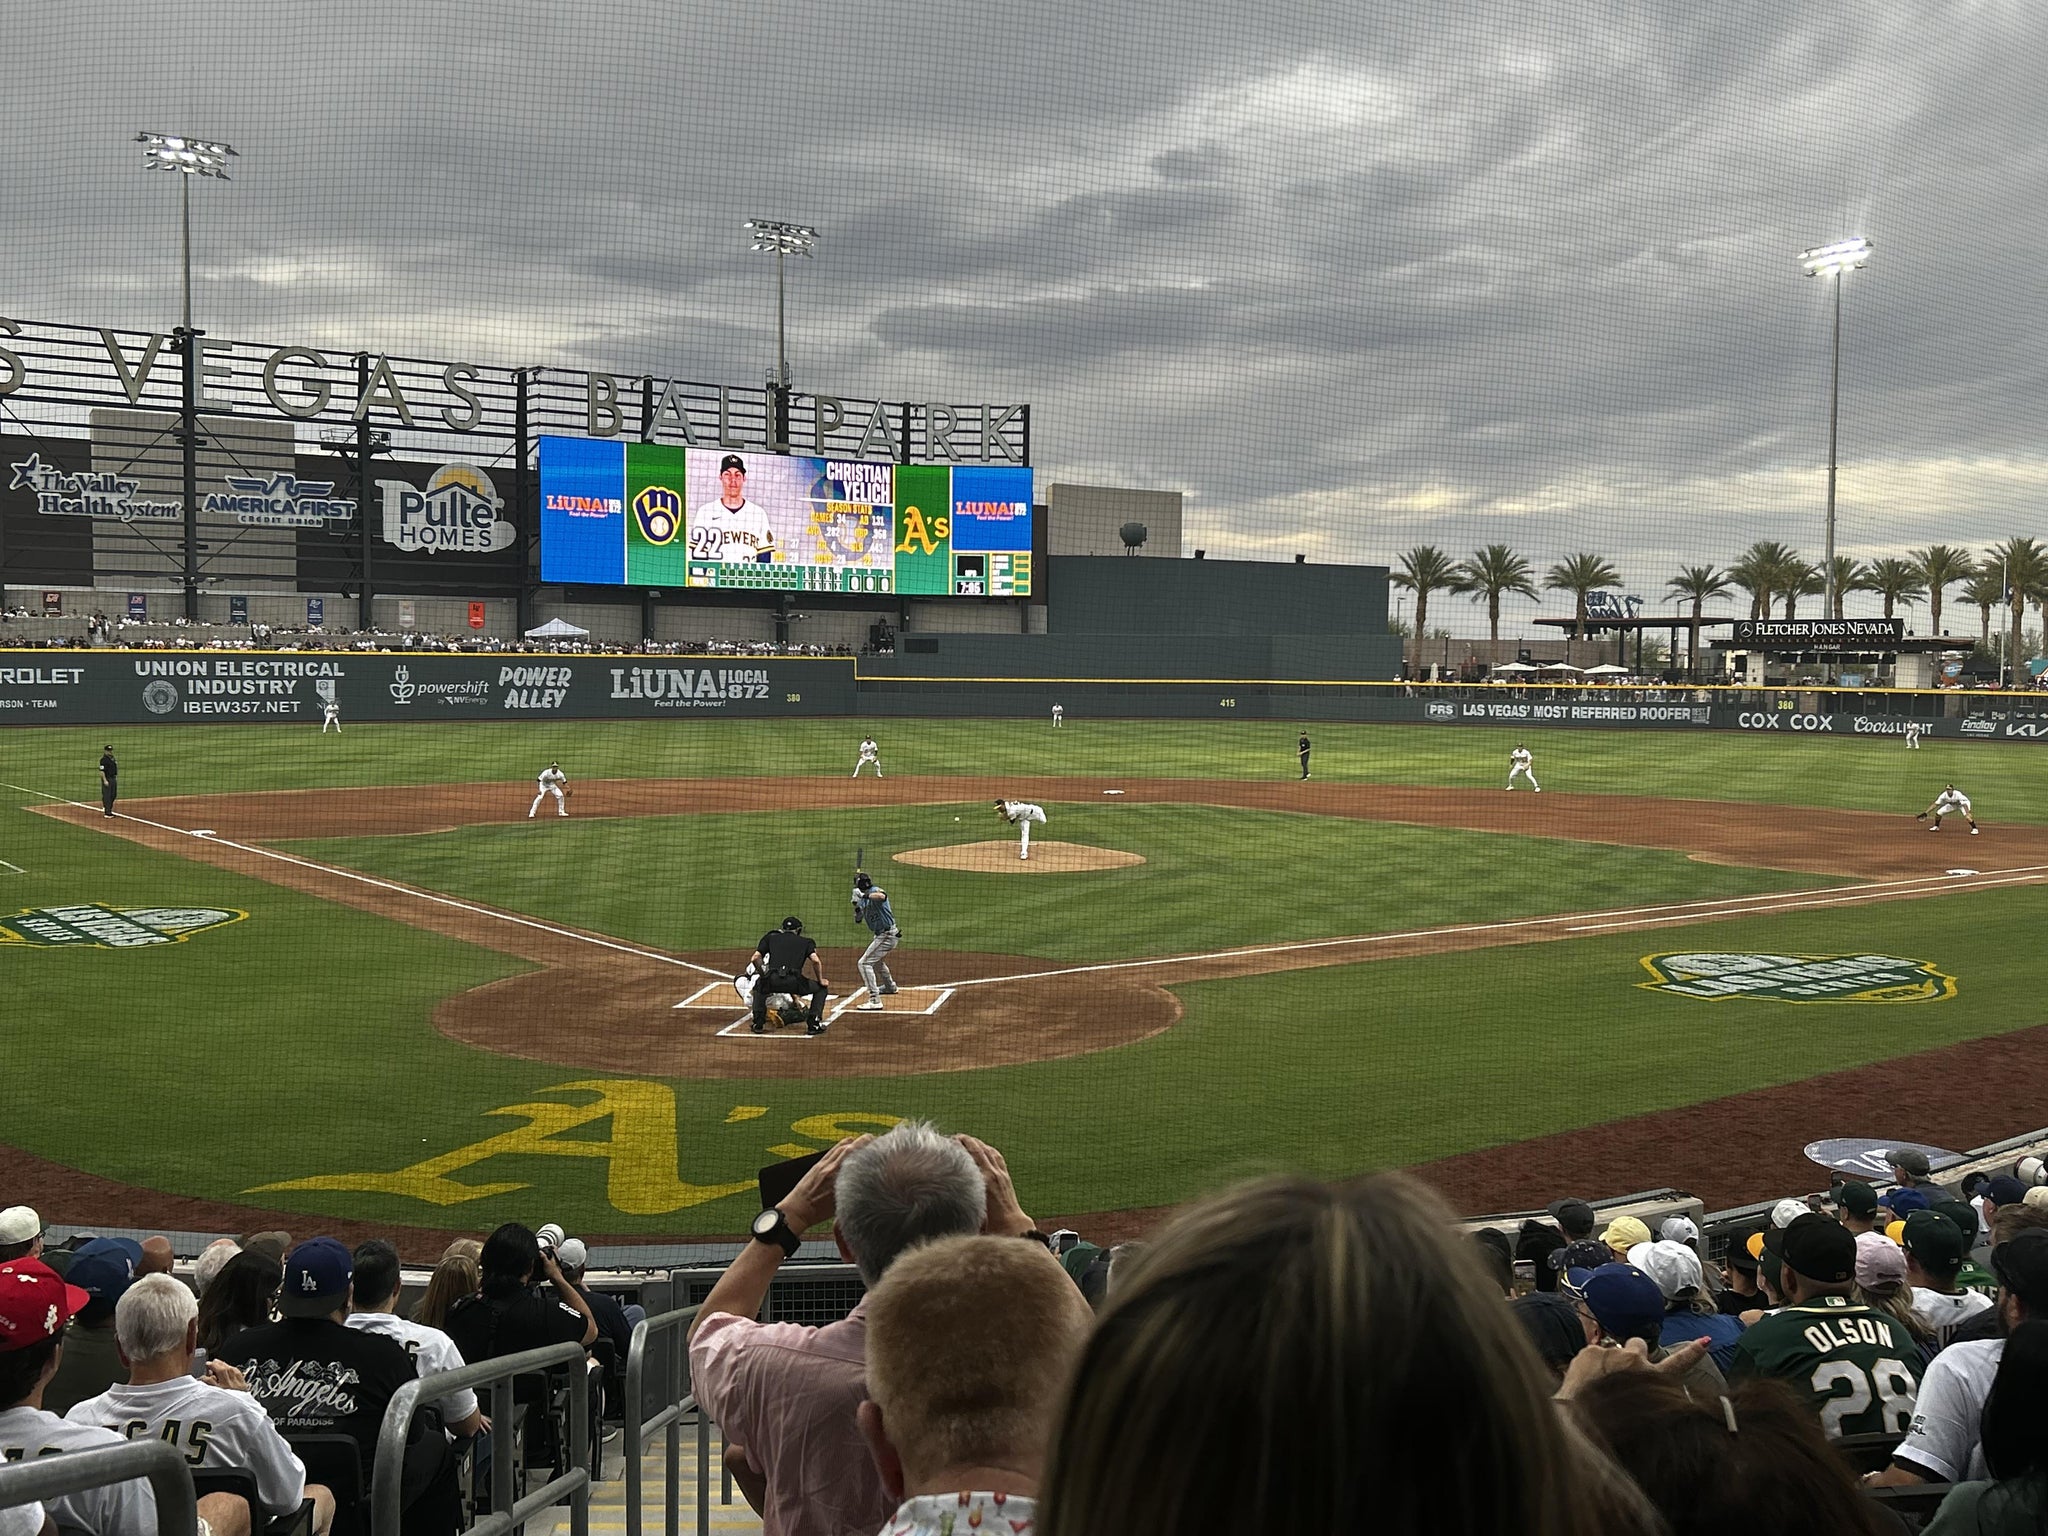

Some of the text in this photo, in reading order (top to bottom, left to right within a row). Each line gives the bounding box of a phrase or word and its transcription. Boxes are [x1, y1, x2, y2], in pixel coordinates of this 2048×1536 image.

[100, 328, 483, 431] VEGAS
[588, 371, 1021, 463] BALLPARK
[826, 461, 891, 483] CHRISTIAN
[40, 472, 139, 498] The Valley
[843, 480, 891, 504] YELICH
[41, 494, 178, 521] Health System
[205, 495, 356, 518] AMERICA FIRST
[400, 491, 494, 529] Pulte
[827, 502, 873, 514] SEASON STATS
[240, 515, 322, 526] CREDIT UNION
[811, 512, 833, 523] GAMES
[837, 513, 846, 524] 34
[400, 526, 492, 547] HOMES
[895, 505, 949, 556] A's
[692, 526, 723, 560] 22
[960, 582, 981, 594] 7:05
[1756, 621, 1895, 638] FLETCHER JONES NEVADA
[135, 660, 345, 677] UNION ELECTRICAL
[498, 666, 572, 688] POWER
[727, 669, 770, 684] LOCAL
[187, 679, 298, 695] INDUSTRY
[417, 680, 490, 697] powershift
[610, 666, 727, 699] LiUNA!
[727, 684, 769, 699] 872
[31, 699, 58, 708] TEAM
[183, 700, 301, 714] IBEW357.NET
[504, 688, 567, 709] ALLEY
[654, 699, 674, 707] Feel
[692, 699, 726, 708] Power!
[1220, 698, 1236, 707] 415
[1777, 700, 1794, 710] 380
[1429, 704, 1454, 715] PRS
[1463, 703, 1485, 716] LAS
[1487, 704, 1531, 718] VEGAS'
[1533, 705, 1569, 719] MOST
[1571, 706, 1637, 720] REFERRED
[1639, 707, 1691, 721] ROOFER
[1738, 712, 1833, 731] COX COX
[1853, 716, 1934, 735] Coors LIHT
[1961, 719, 1997, 732] Findlay
[15, 917, 84, 942] SERIES
[1661, 955, 1918, 996] LAS VEGAS
[1780, 972, 1912, 995] SERIES
[301, 1270, 317, 1291] LA
[1803, 1317, 1894, 1353] OLSON
[260, 1360, 358, 1417] Angeles
[1810, 1357, 1918, 1441] 28
[286, 1418, 334, 1427] PARADISE
